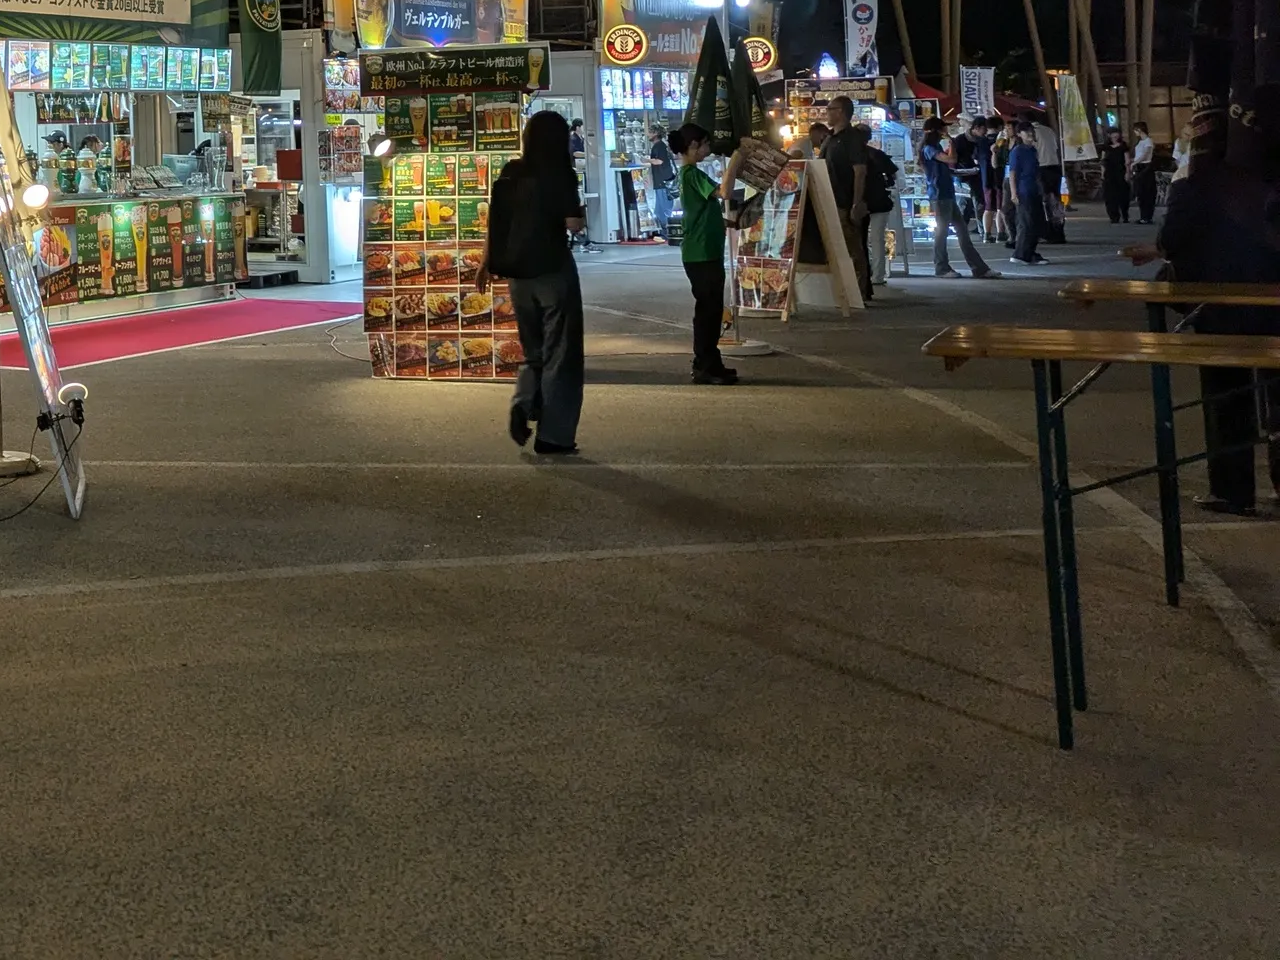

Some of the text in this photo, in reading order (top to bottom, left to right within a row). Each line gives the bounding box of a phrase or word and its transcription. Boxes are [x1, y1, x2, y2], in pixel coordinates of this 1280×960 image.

[404, 8, 471, 30] ヴェルテンブルガー
[608, 28, 640, 43] ERDINGER
[77, 277, 95, 288] ¥1,500
[115, 275, 133, 286] ¥1,600
